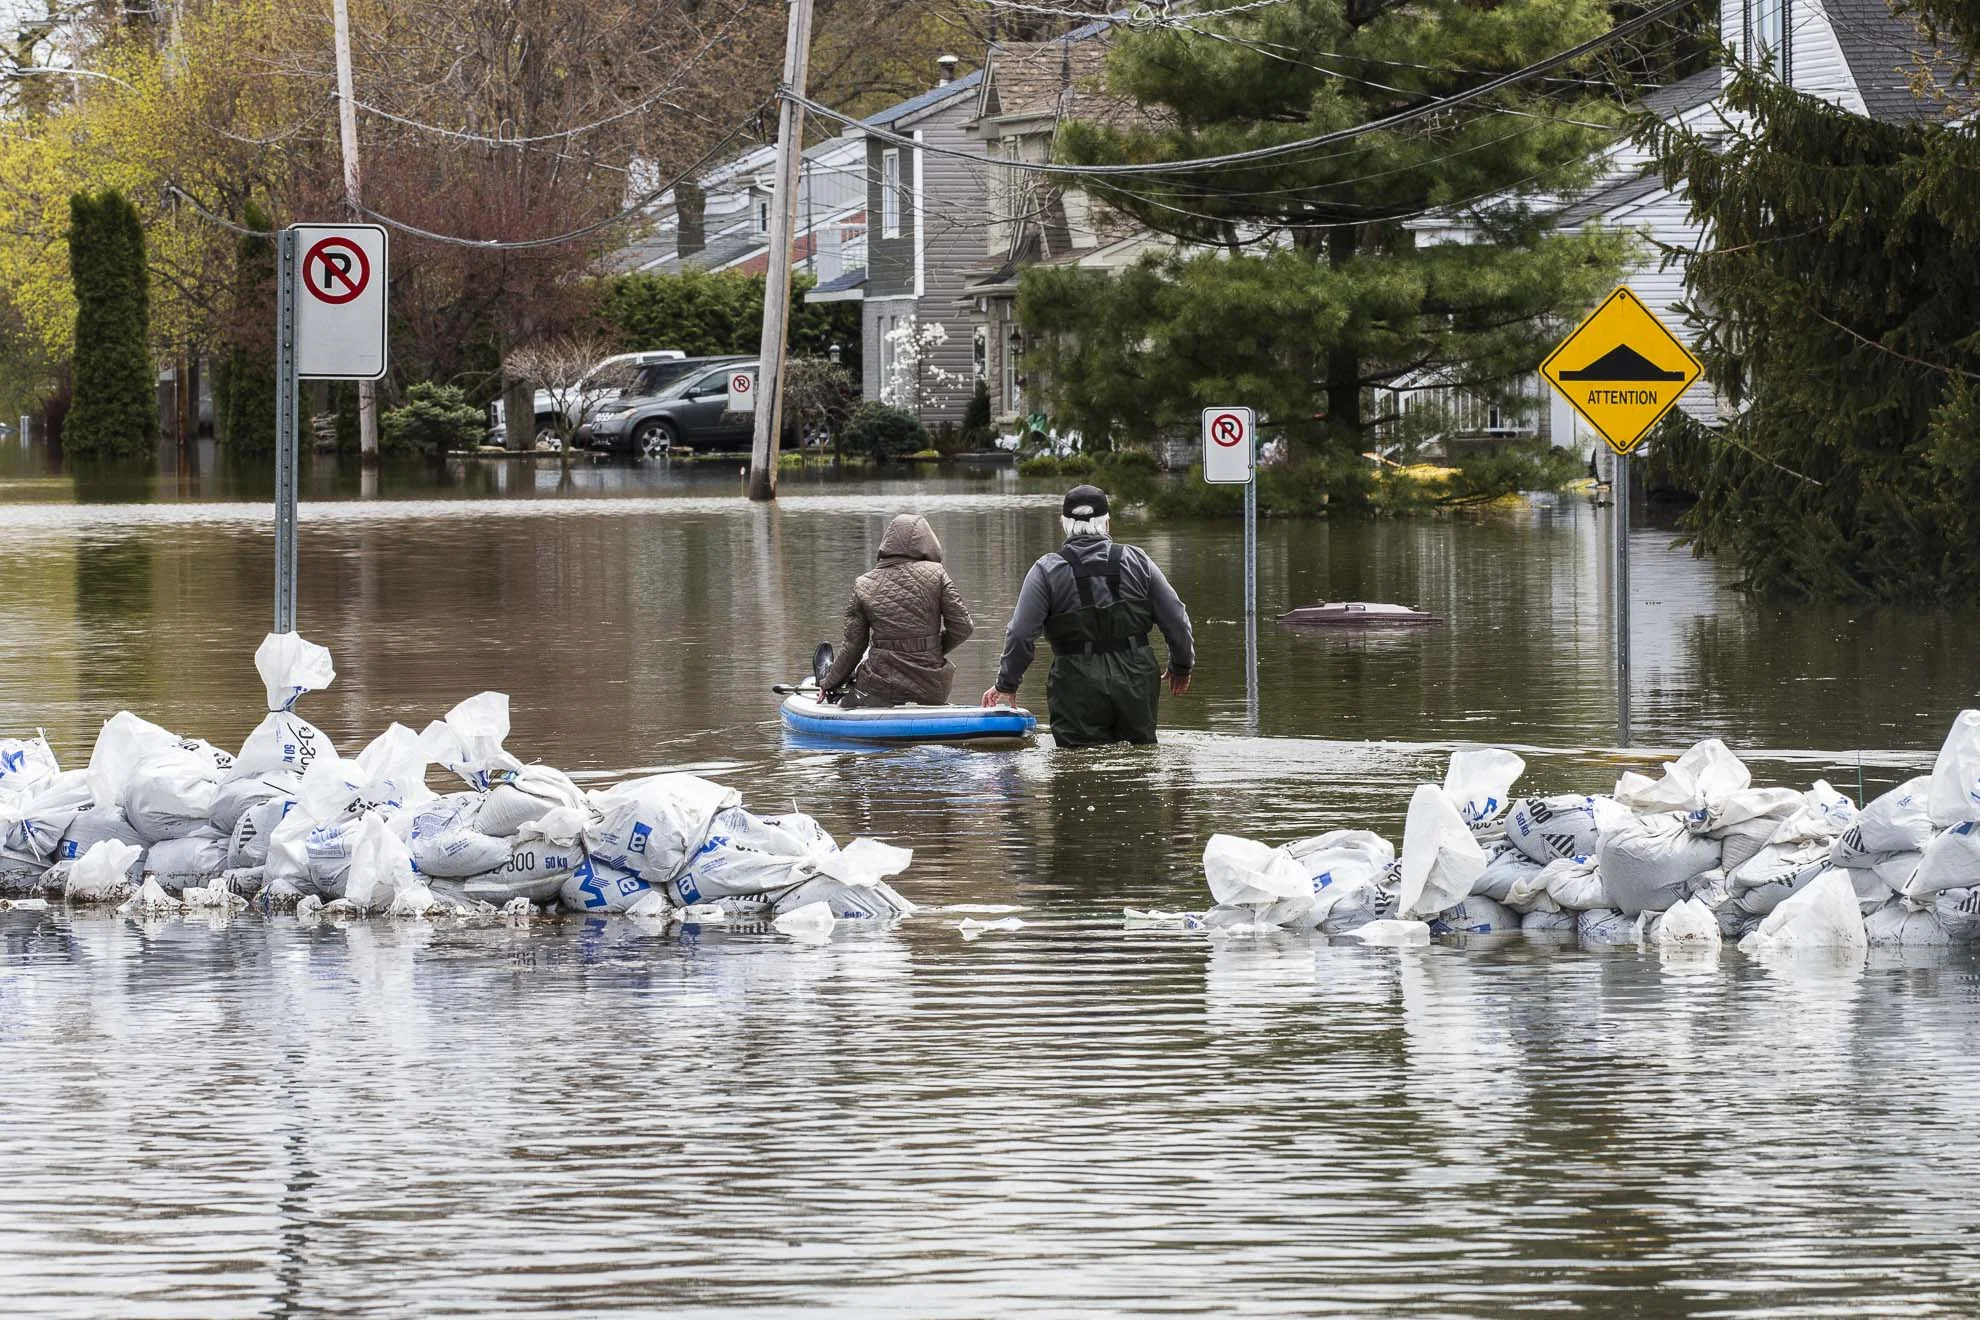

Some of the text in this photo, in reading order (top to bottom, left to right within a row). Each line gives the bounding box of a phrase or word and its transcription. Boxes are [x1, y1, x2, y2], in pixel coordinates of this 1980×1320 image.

[324, 252, 352, 289] P
[1588, 390, 1657, 405] ATTENTION
[544, 856, 556, 869] 50
[556, 855, 568, 871] kg
